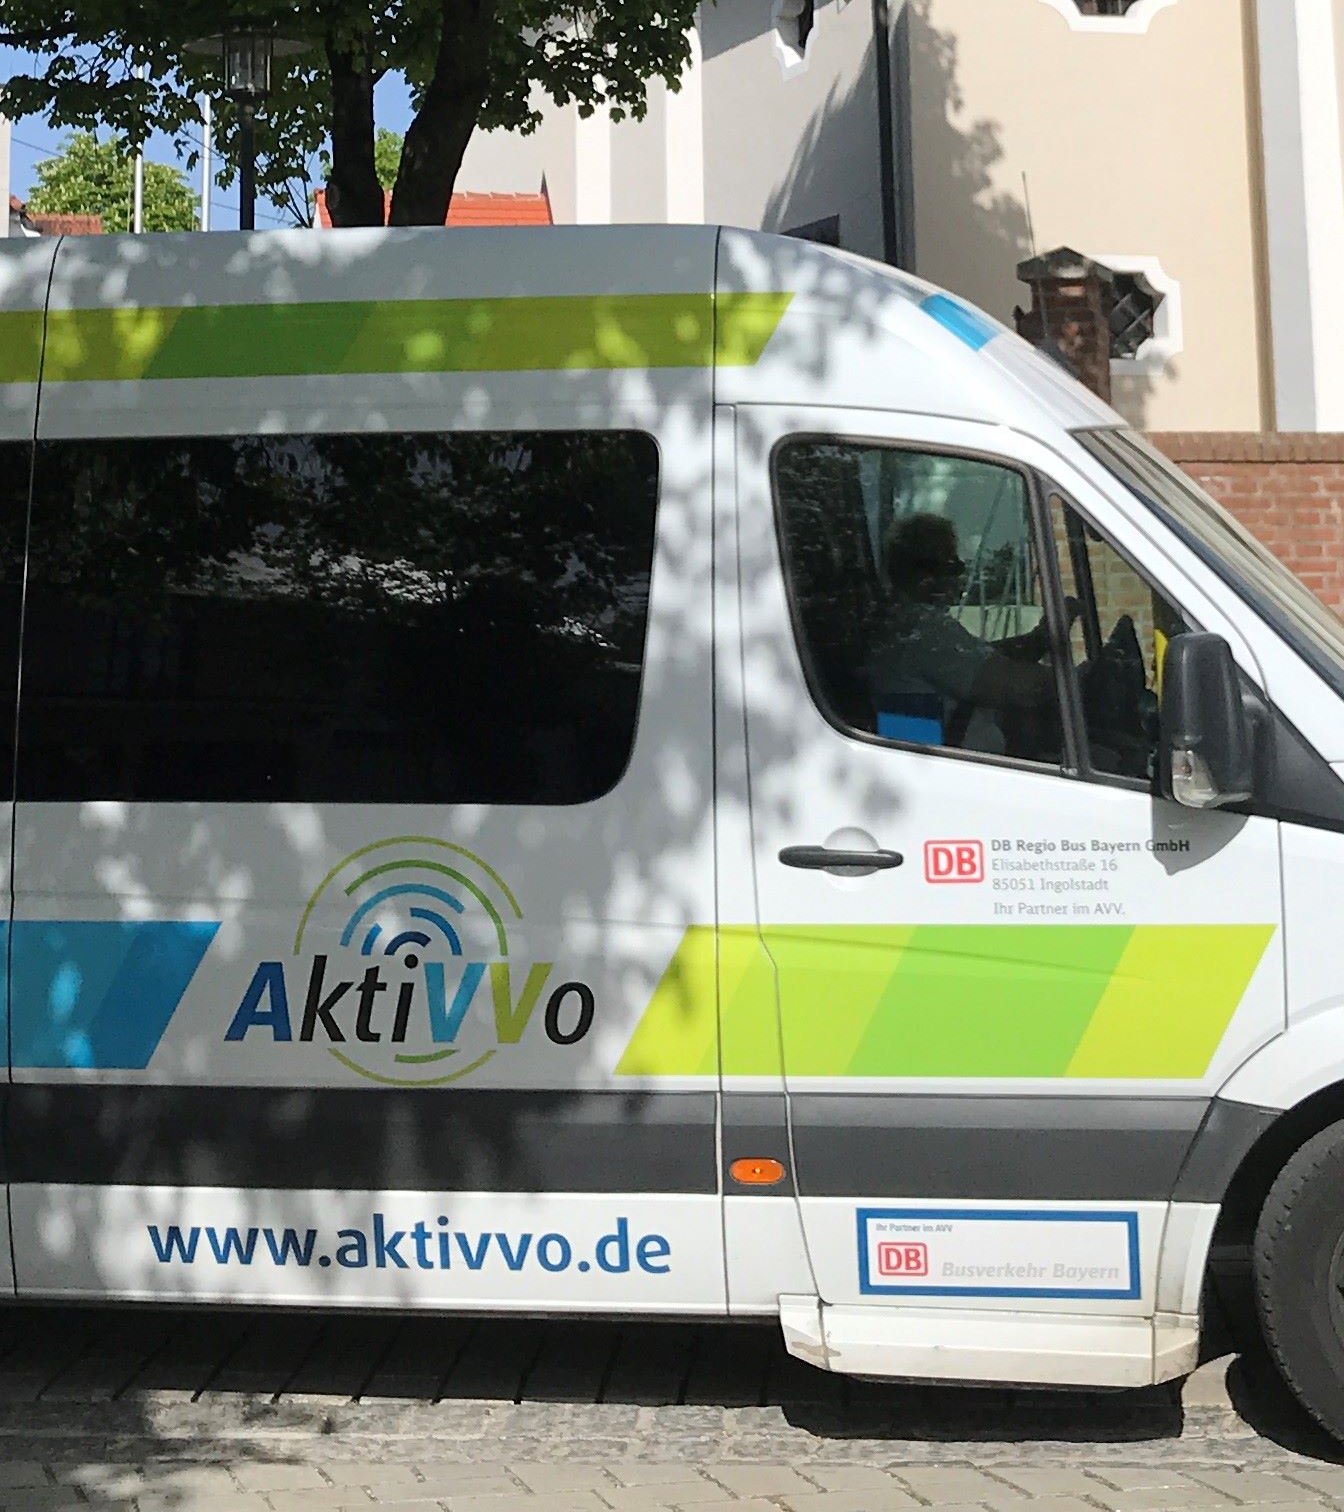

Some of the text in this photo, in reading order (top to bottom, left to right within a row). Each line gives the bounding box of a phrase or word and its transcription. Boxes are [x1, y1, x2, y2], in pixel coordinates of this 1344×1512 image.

[991, 839, 1191, 855] DB Regio Bus Bayern GmbH
[932, 847, 977, 876] DB
[992, 857, 1118, 871] Elisabethstraße 16
[992, 877, 1109, 894] 85051 Ingolstadt
[993, 902, 1126, 915] Ihr Partner im AVV.
[224, 954, 595, 1045] AktiVVo
[889, 1223, 921, 1232] Partner
[147, 1214, 671, 1274] www.aktivvo.de
[885, 1248, 922, 1270] DB
[941, 1262, 1120, 1281] Busverkehr Bayern
